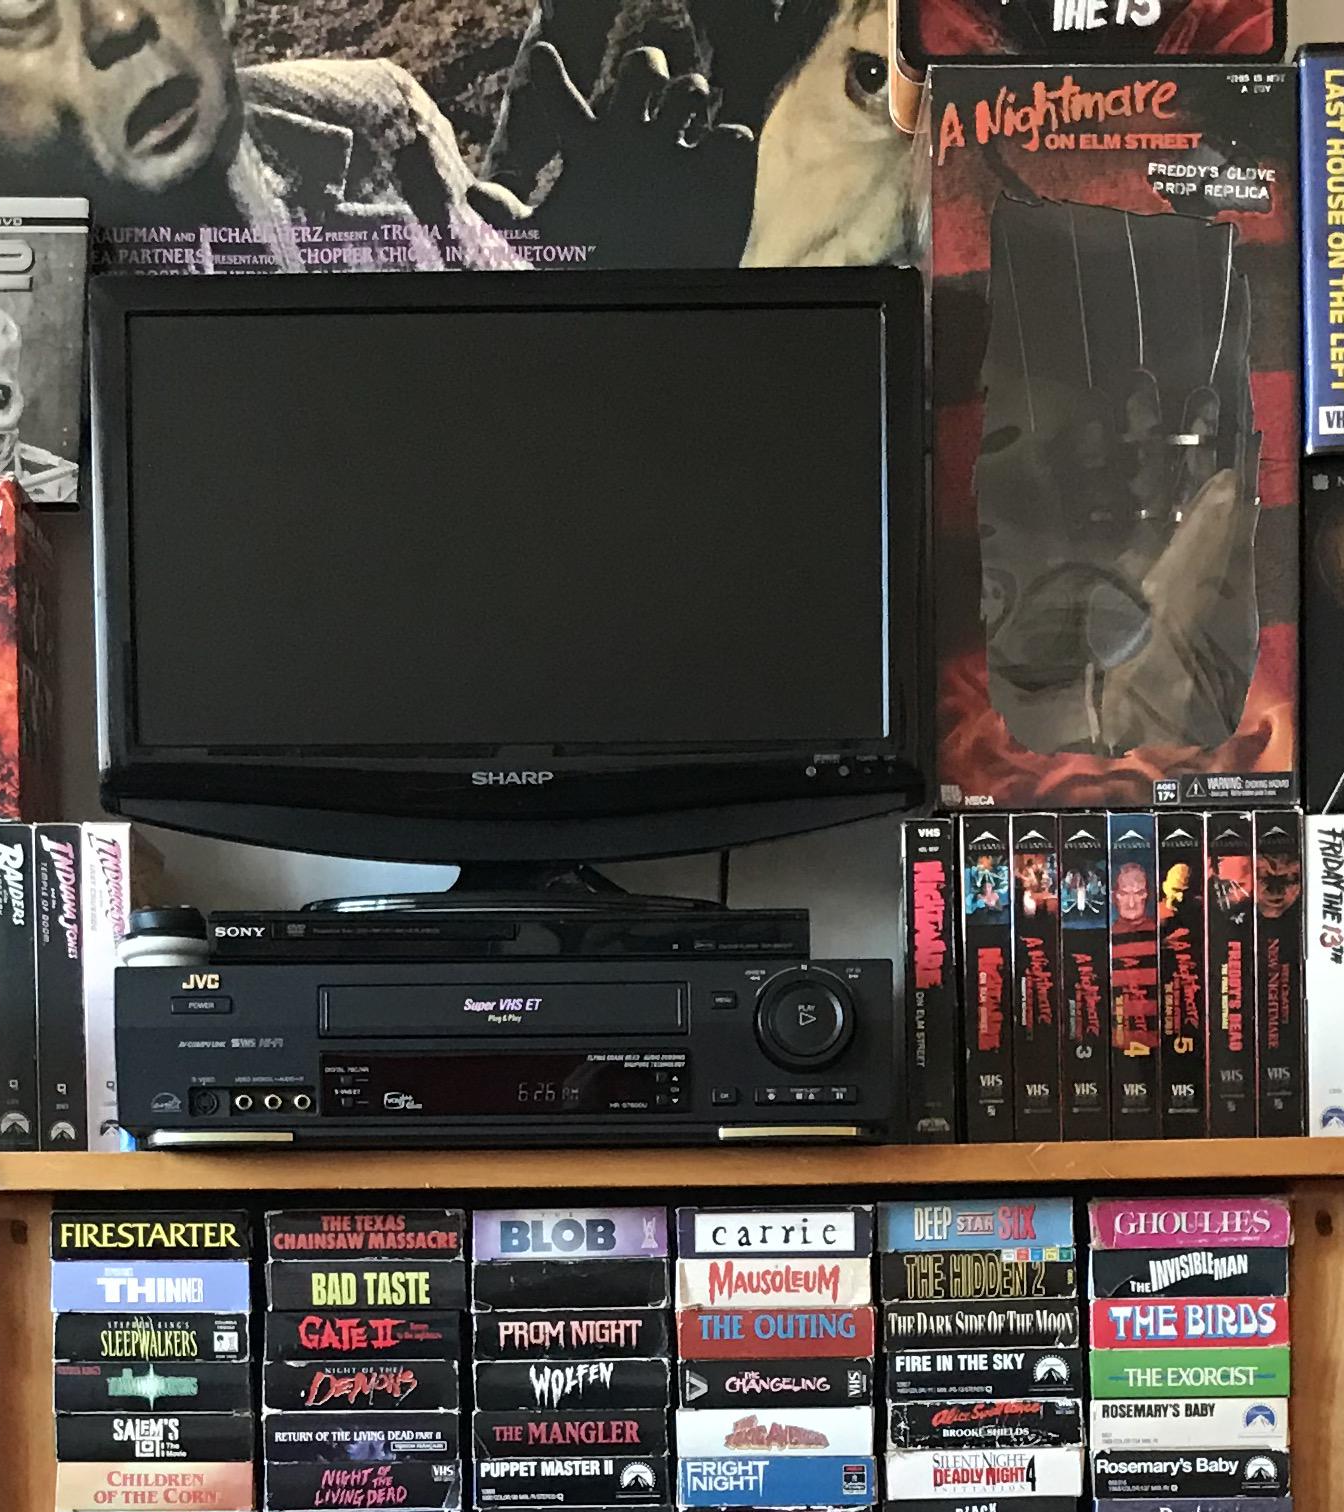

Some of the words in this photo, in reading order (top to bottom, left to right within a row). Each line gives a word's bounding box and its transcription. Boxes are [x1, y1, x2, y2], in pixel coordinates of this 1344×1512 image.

[938, 102, 965, 165] A
[975, 75, 1177, 151] Nightmare
[1045, 134, 1075, 149] ON
[1080, 134, 1121, 149] ELM
[1125, 133, 1202, 149] STREET
[1148, 163, 1220, 179] FREDDY'S
[1227, 167, 1276, 183] GLOVE
[1153, 181, 1195, 196] PROP
[1205, 184, 1270, 199] REPLICA
[119, 247, 204, 264] PARTNERS
[472, 770, 554, 787] SHARP
[215, 927, 265, 938] SONY
[182, 974, 219, 990] JVC
[464, 998, 495, 1013] Super
[499, 998, 523, 1011] VHS
[526, 998, 542, 1011] ET
[60, 1223, 240, 1249] FIRESTARTER
[500, 1220, 617, 1252] BLOB
[713, 1223, 837, 1248] carrie
[312, 1273, 357, 1305] BAD
[365, 1272, 431, 1305] TASTE
[1109, 1306, 1180, 1339] THE
[1187, 1303, 1277, 1339] BIRDS
[896, 1355, 929, 1372] FIRE
[934, 1355, 951, 1371] IN
[957, 1355, 985, 1370] THE
[992, 1354, 1025, 1370] SKY
[1125, 1369, 1161, 1386] THE
[1166, 1366, 1257, 1386] EXORCIST
[1096, 1458, 1193, 1475] Rosemary's
[1199, 1458, 1239, 1475] Baby
